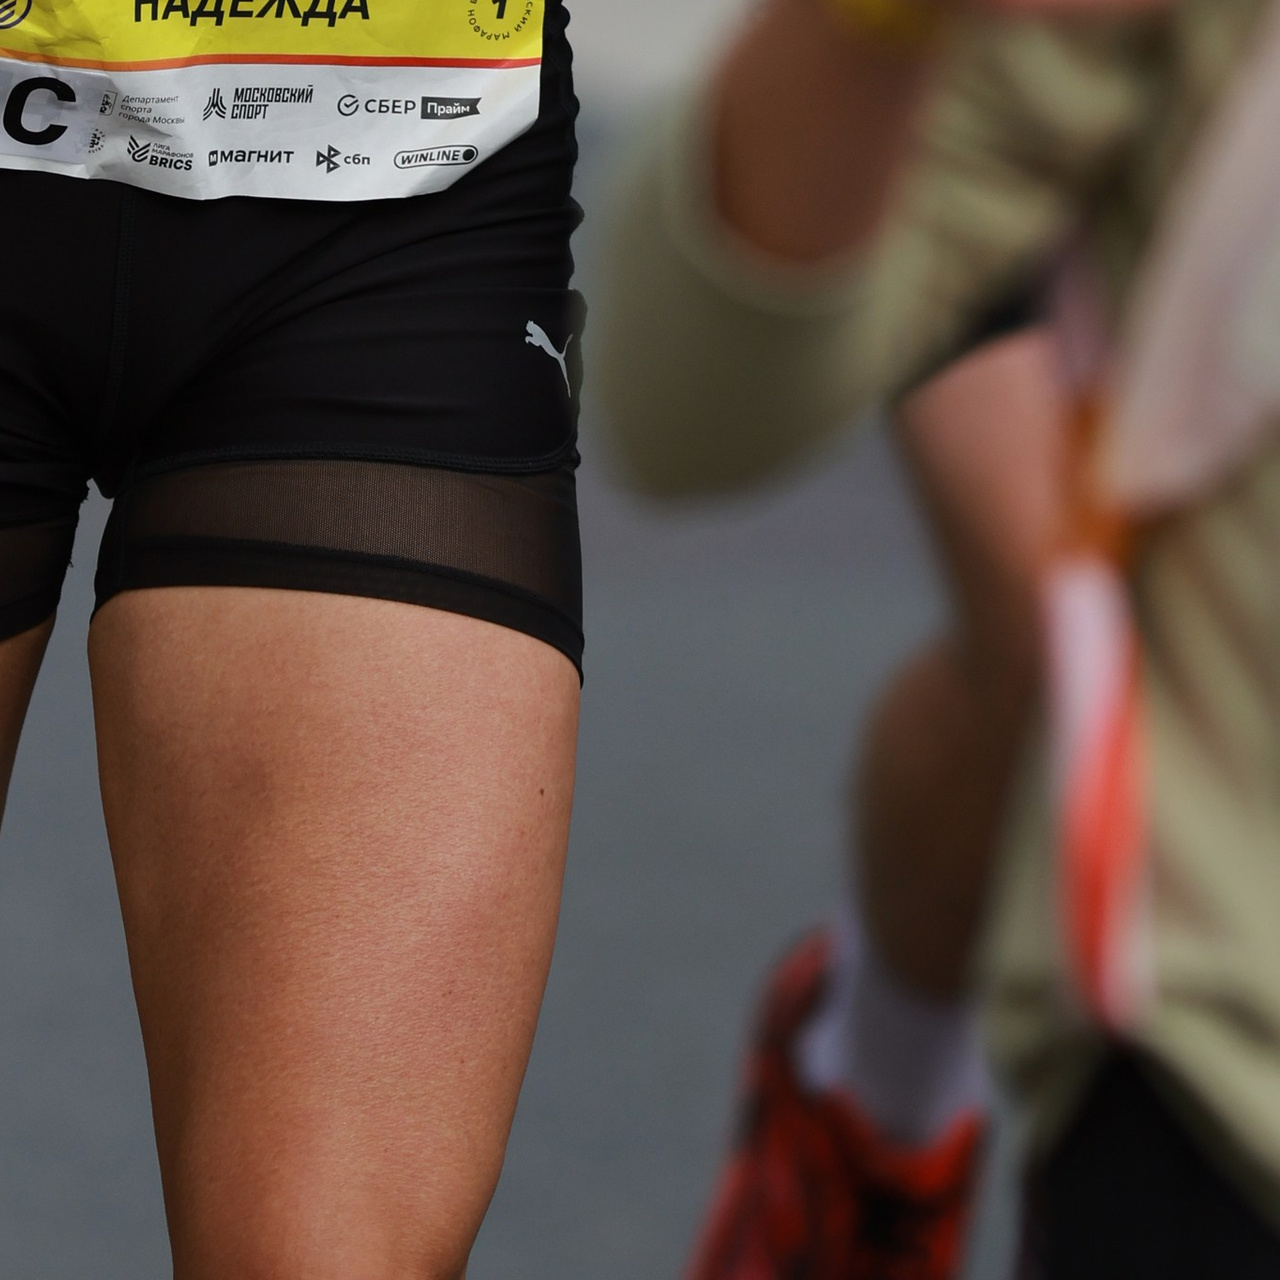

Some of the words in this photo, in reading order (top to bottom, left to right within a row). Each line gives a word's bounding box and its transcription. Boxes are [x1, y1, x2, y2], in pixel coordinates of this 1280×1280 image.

[122, 95, 179, 105] Департамент
[233, 84, 314, 103] МОСКОВСКИЙ
[120, 104, 152, 114] спорта
[231, 104, 269, 119] СПОРТ
[364, 99, 416, 115] СБЕР
[427, 102, 470, 116] Прайм
[118, 111, 150, 124] города
[152, 116, 186, 125] Москвы
[153, 142, 171, 151] ЛИГА
[149, 154, 193, 171] BRICS
[400, 149, 461, 165] WINLINE
